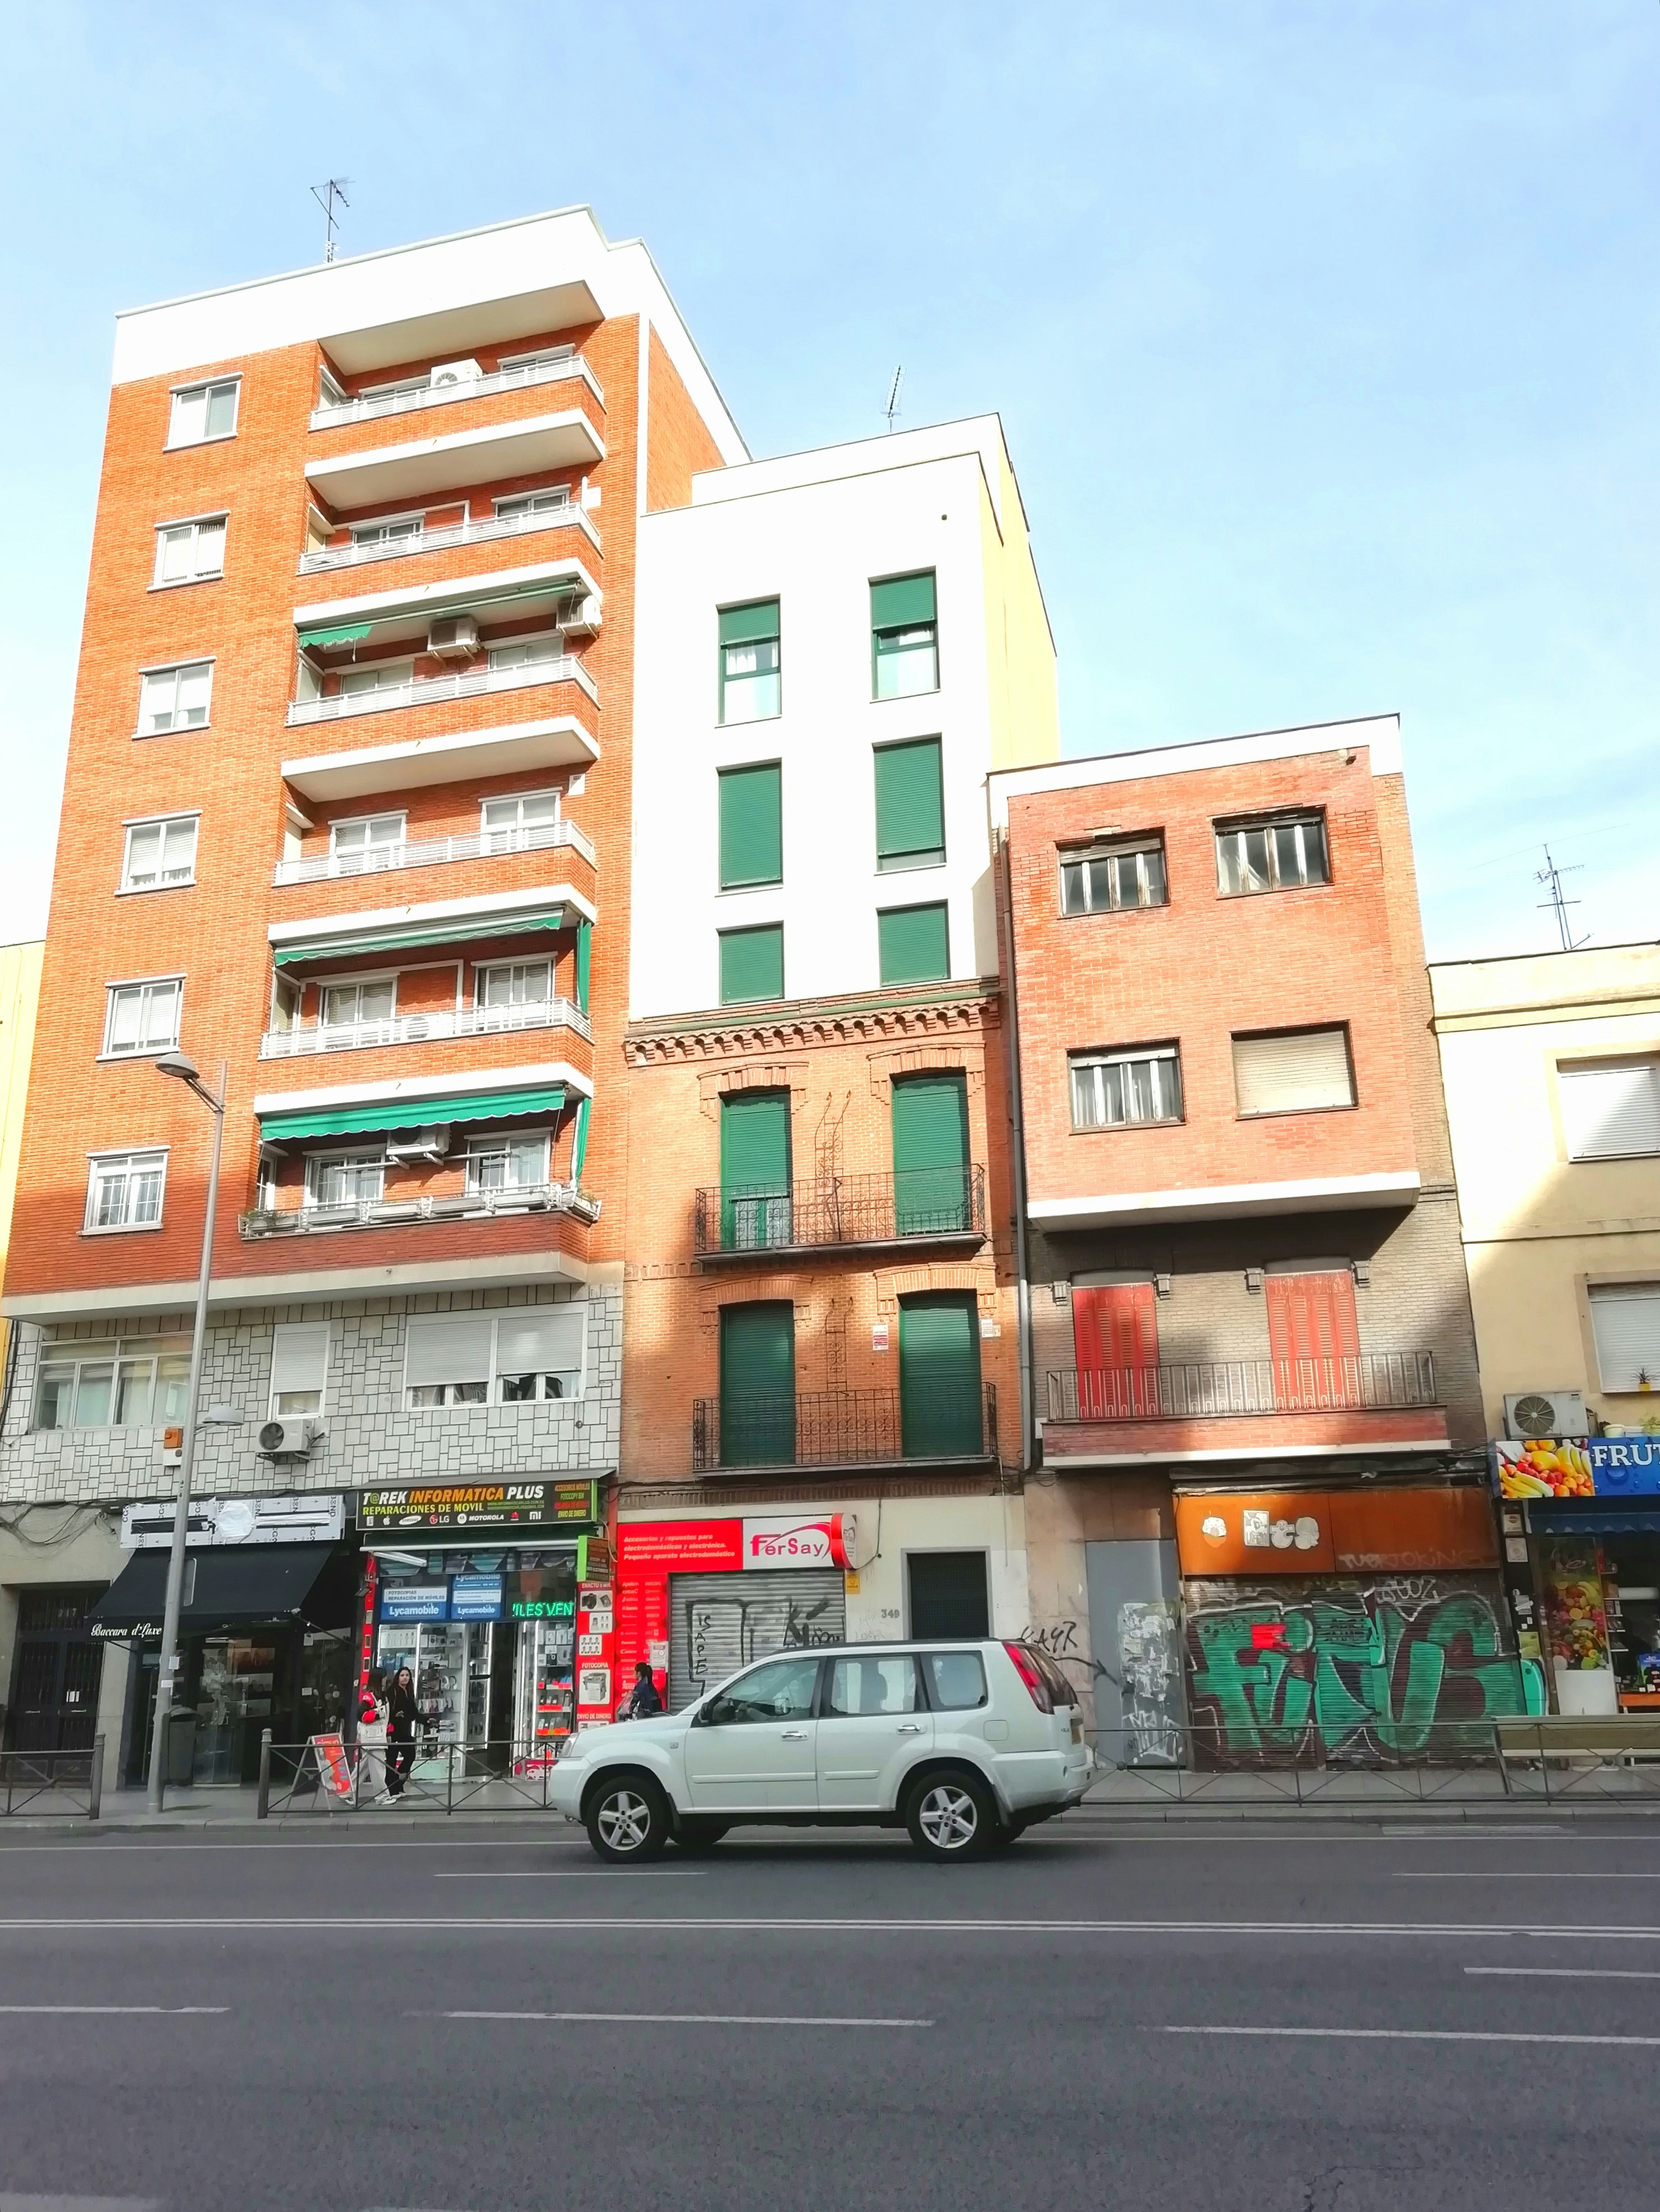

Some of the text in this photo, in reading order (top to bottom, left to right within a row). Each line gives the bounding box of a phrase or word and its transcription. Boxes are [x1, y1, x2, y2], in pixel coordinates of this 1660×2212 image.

[363, 1485, 544, 1505] T@REK INFORMATICA PLUS
[363, 1505, 435, 1515] REPARACIONES
[438, 1503, 451, 1512] DE
[454, 1502, 484, 1512] MOVIL
[750, 1534, 824, 1557] FerSay
[389, 1604, 440, 1616] Lycamobile
[458, 1606, 495, 1615] Lycamobile
[881, 1608, 900, 1618] 349
[91, 1623, 127, 1636] Baccara
